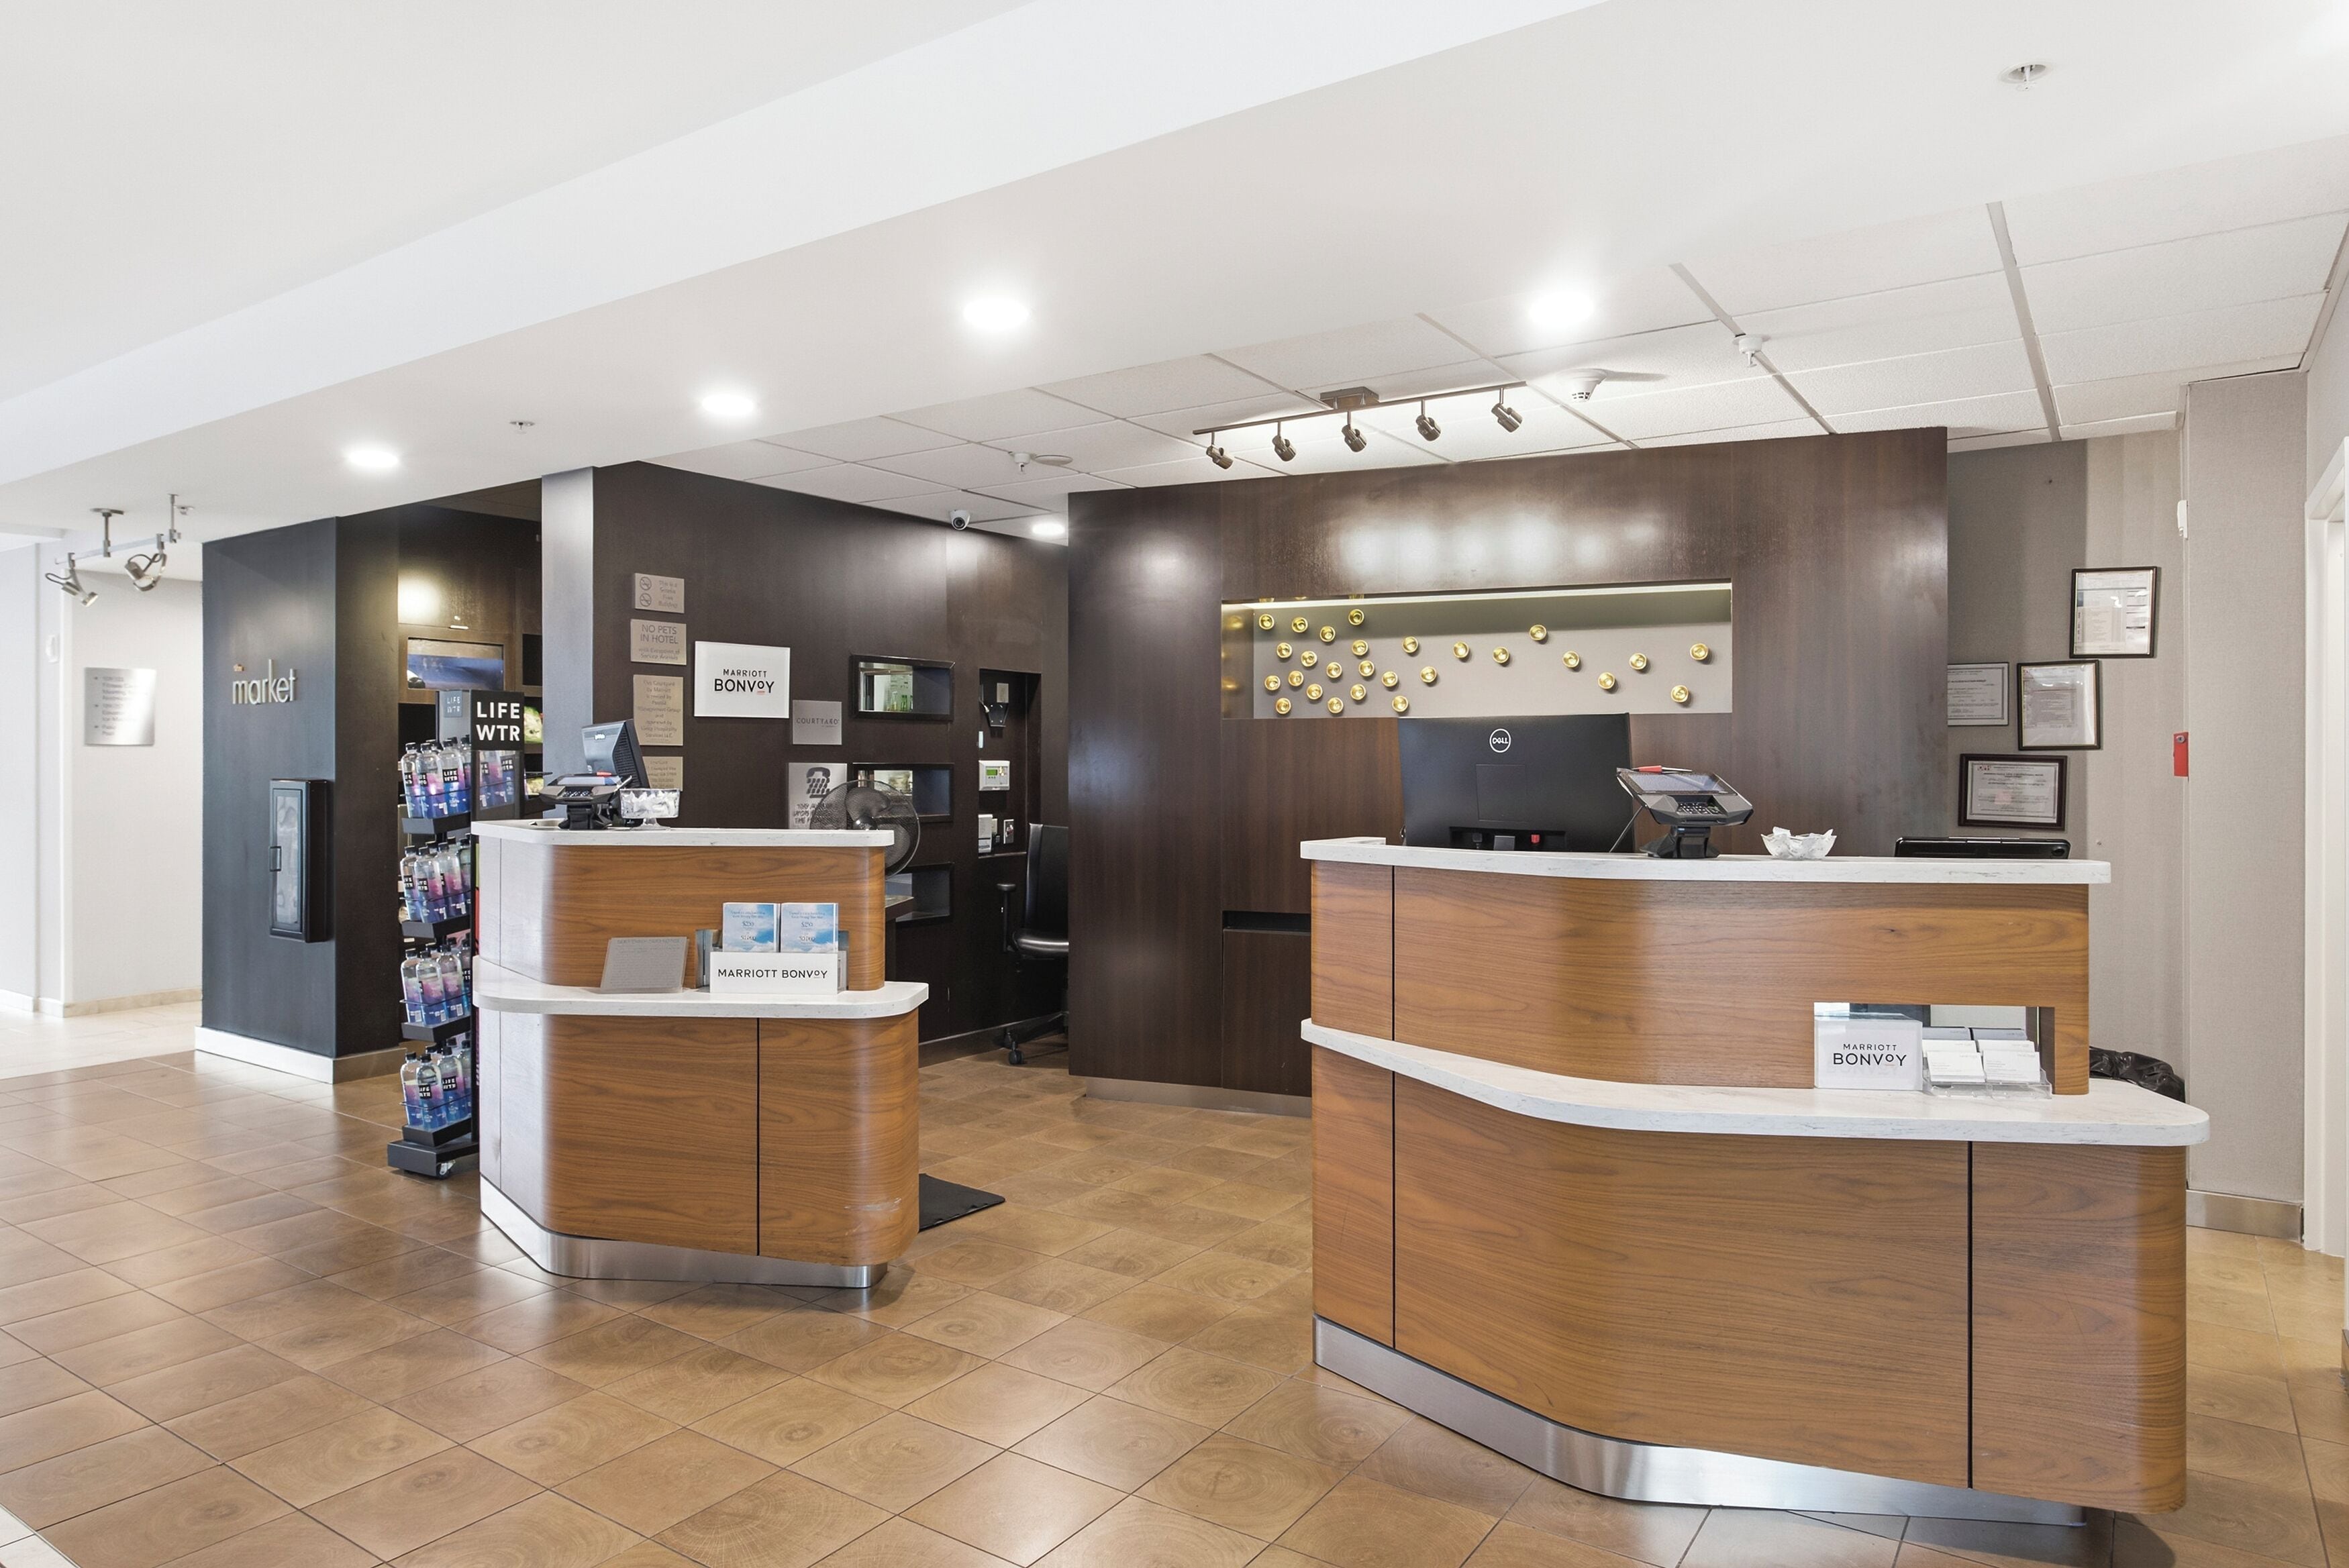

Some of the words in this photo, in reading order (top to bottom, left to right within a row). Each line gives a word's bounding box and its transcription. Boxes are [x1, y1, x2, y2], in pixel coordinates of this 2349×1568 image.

[642, 624, 656, 633] NO
[658, 625, 677, 635] PETS
[640, 633, 650, 642] IN
[652, 634, 679, 644] HOTEL
[723, 669, 767, 678] MARRIOTT
[232, 659, 296, 704] market
[714, 678, 774, 693] BONVOY
[477, 701, 520, 719] LIFE
[476, 725, 520, 741] WTR
[718, 969, 777, 978] MARRIOTT
[782, 970, 828, 979] BONVOY
[1833, 1053, 1907, 1066] BONVOY
